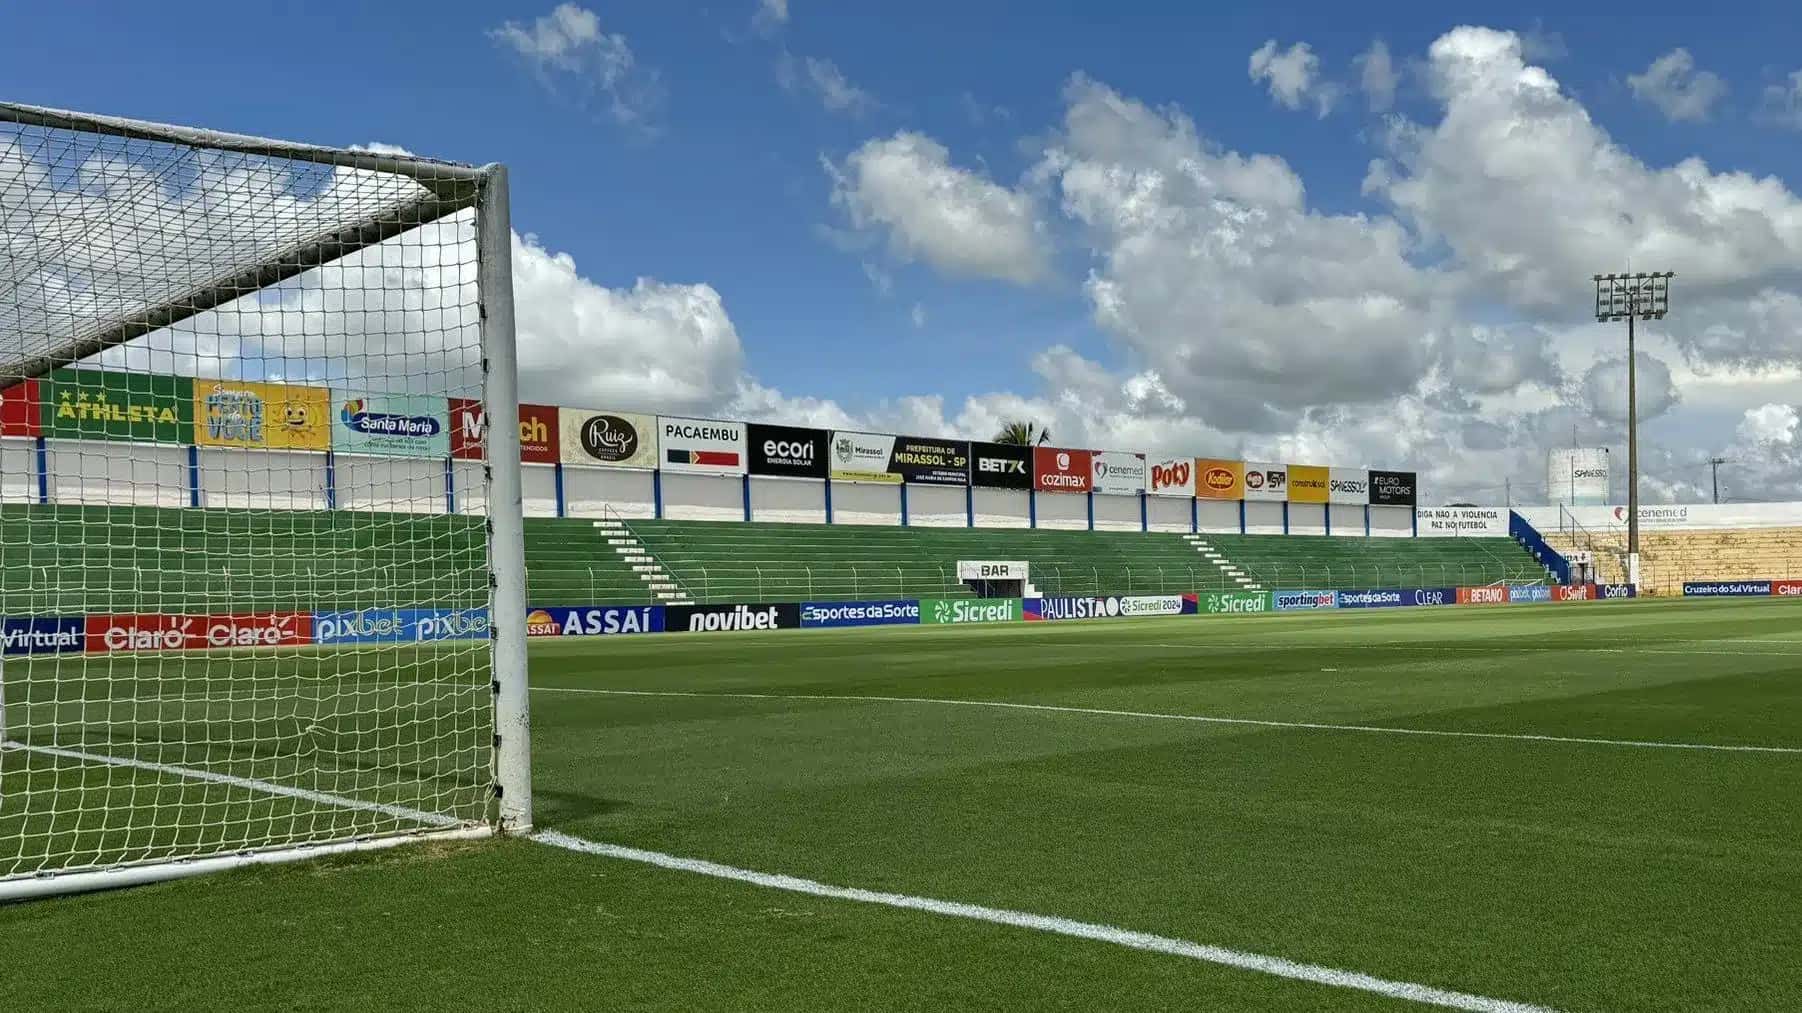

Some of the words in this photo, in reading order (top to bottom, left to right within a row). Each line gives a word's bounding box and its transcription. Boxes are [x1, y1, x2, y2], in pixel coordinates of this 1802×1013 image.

[57, 401, 177, 424] ATHLETA
[361, 417, 396, 432] Santa
[399, 419, 432, 434] Maria
[666, 424, 739, 442] PACAEMBU
[589, 418, 633, 453] Ruiz
[763, 439, 814, 460] ecori
[855, 446, 883, 456] Mirassol
[906, 444, 945, 455] PREFEITURA
[946, 447, 955, 455] DE
[767, 457, 792, 465] ENERGIA
[793, 458, 812, 467] SOLAR
[895, 452, 946, 467] MIRASSOL
[953, 456, 966, 467] SP
[1041, 472, 1086, 487] cozimax
[1379, 476, 1400, 486] EURO
[1379, 486, 1411, 495] MOTORS
[1417, 510, 1433, 519] DIGA
[1431, 520, 1444, 529] PAZ
[1445, 520, 1456, 529] NO
[1458, 520, 1487, 529] FUTEBOL
[981, 564, 1009, 577] BAR
[1471, 588, 1503, 603] BETANO
[1567, 585, 1587, 600] Swift
[1604, 584, 1628, 598] Corfio
[1685, 584, 1718, 594] Cruzeiro
[1718, 584, 1729, 593] do
[1729, 584, 1742, 593] Sul
[1743, 583, 1770, 593] Virtual
[1132, 599, 1161, 612] Sicredi
[1162, 598, 1181, 610] 2024
[1221, 593, 1265, 613] Sicredi
[1278, 591, 1334, 608] sportingbet
[689, 604, 779, 632] novibet
[802, 605, 865, 623] Esportes
[883, 604, 919, 618] Sorte
[952, 599, 1012, 622] Sicredi
[318, 611, 404, 644] pixbet
[562, 607, 652, 635] ASSAÍ
[1, 626, 79, 648] Virtual
[104, 625, 185, 649] Claro
[209, 622, 281, 646] Claro
